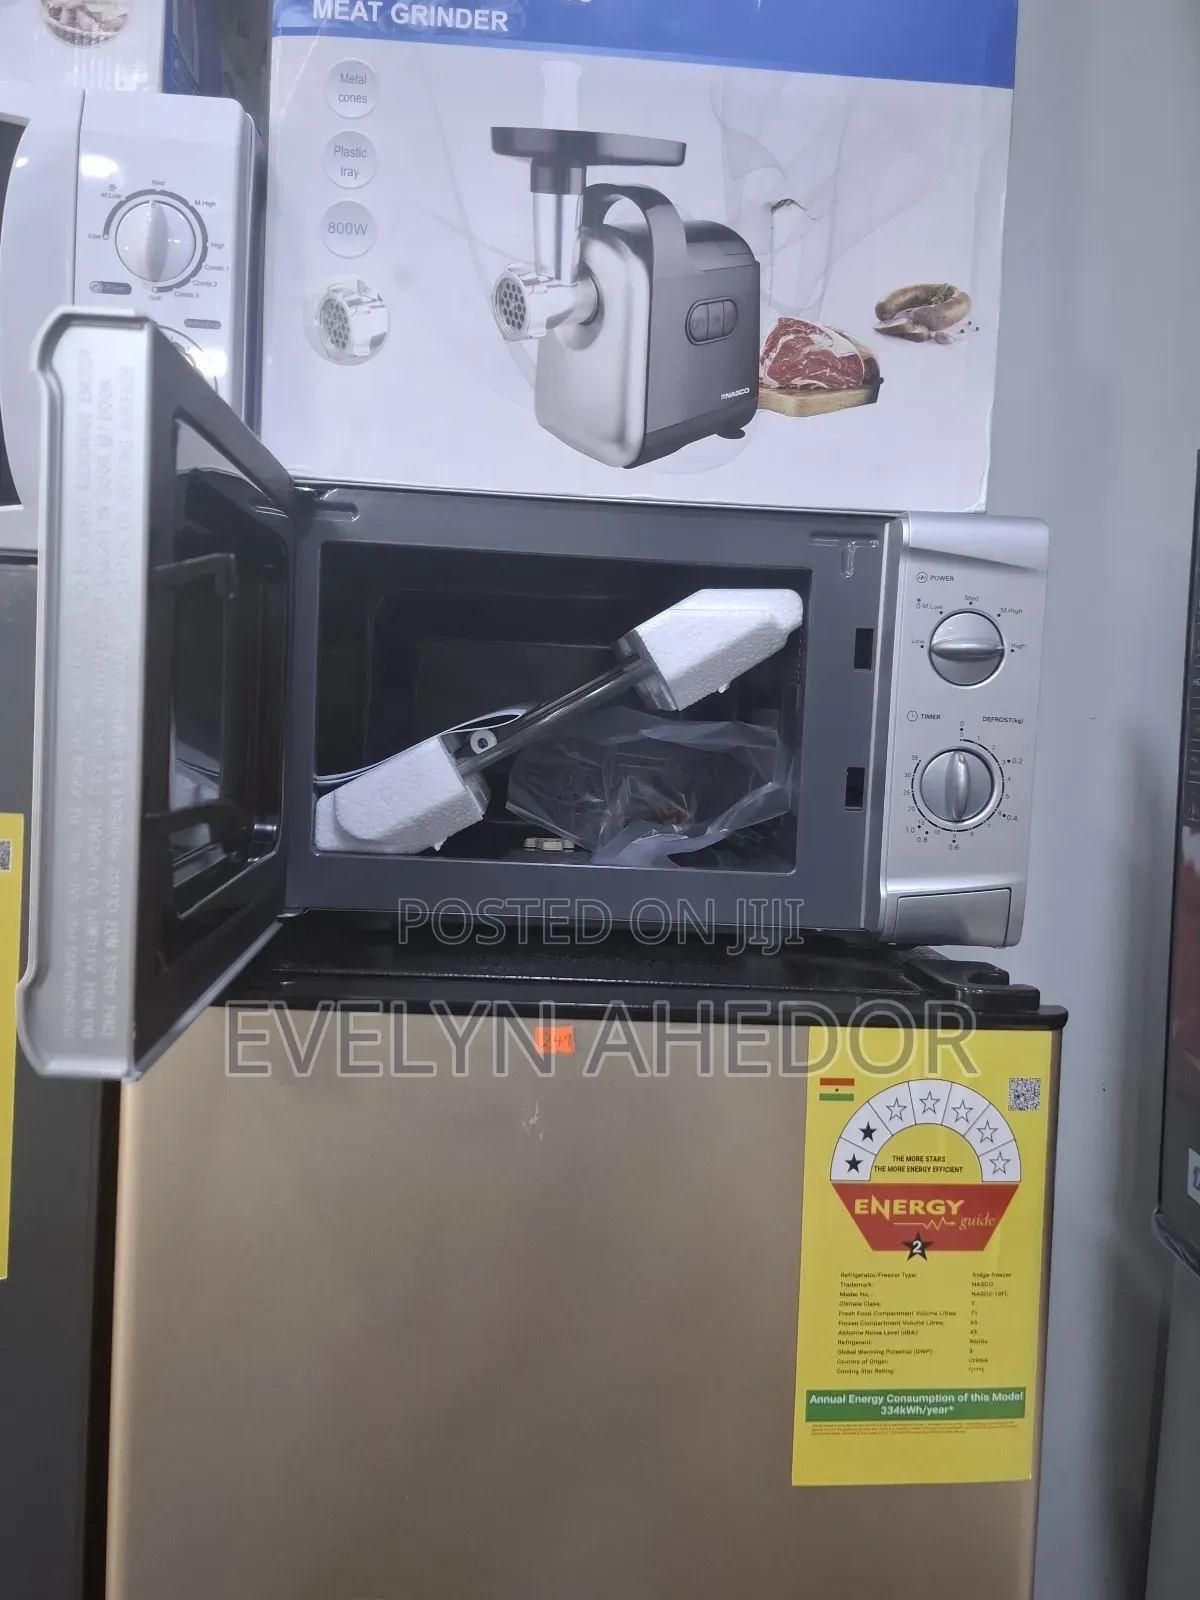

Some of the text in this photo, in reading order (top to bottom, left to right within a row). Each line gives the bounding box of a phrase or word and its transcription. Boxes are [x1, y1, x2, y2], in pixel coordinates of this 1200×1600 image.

[312, 0, 509, 32] MEAT GRINDER
[340, 72, 367, 86] Metal
[338, 92, 368, 104] cones
[333, 145, 368, 159] Plastic
[340, 166, 360, 180] tray
[327, 221, 368, 236] 800W
[929, 574, 955, 582] POWER
[964, 594, 979, 602] Med
[1000, 607, 1023, 615] M.High
[1011, 757, 1023, 765] 0.2
[1006, 814, 1018, 822] 0.4
[905, 826, 915, 834] 1.0
[916, 836, 928, 844] 0.8
[948, 843, 960, 851] 0.6
[892, 1155, 946, 1163] THE MORE STARS
[874, 1165, 964, 1173] THE MORE ENERGY EFFICIENT
[854, 1193, 965, 1221] ENERGY
[958, 1211, 997, 1231] guide
[911, 1240, 923, 1254] 2
[809, 1391, 1023, 1406] Annual Energy Consumption of this Model
